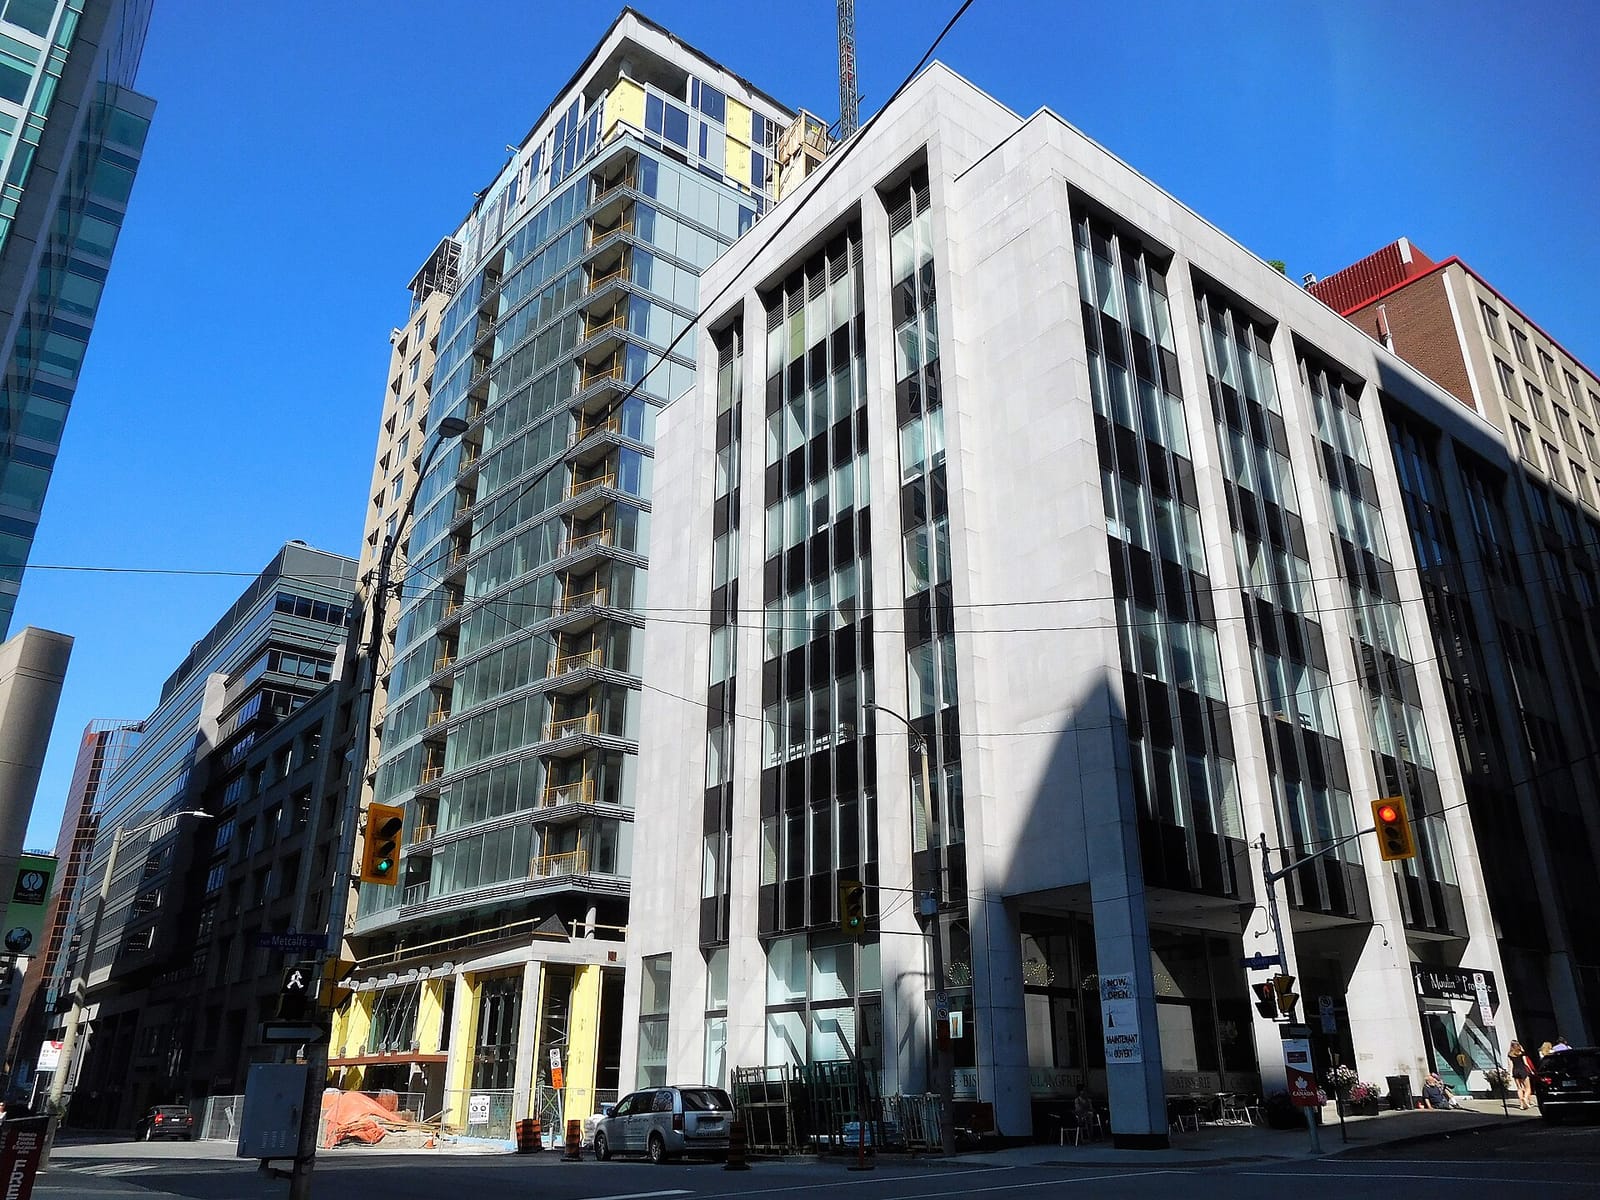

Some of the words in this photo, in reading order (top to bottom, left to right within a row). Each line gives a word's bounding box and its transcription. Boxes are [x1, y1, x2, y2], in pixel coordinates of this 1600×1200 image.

[271, 935, 307, 947] Metcalfe
[1106, 978, 1127, 987] NOW
[1462, 975, 1492, 993] Proe
[1107, 990, 1128, 999] OPEN
[5, 1159, 28, 1200] FRE
